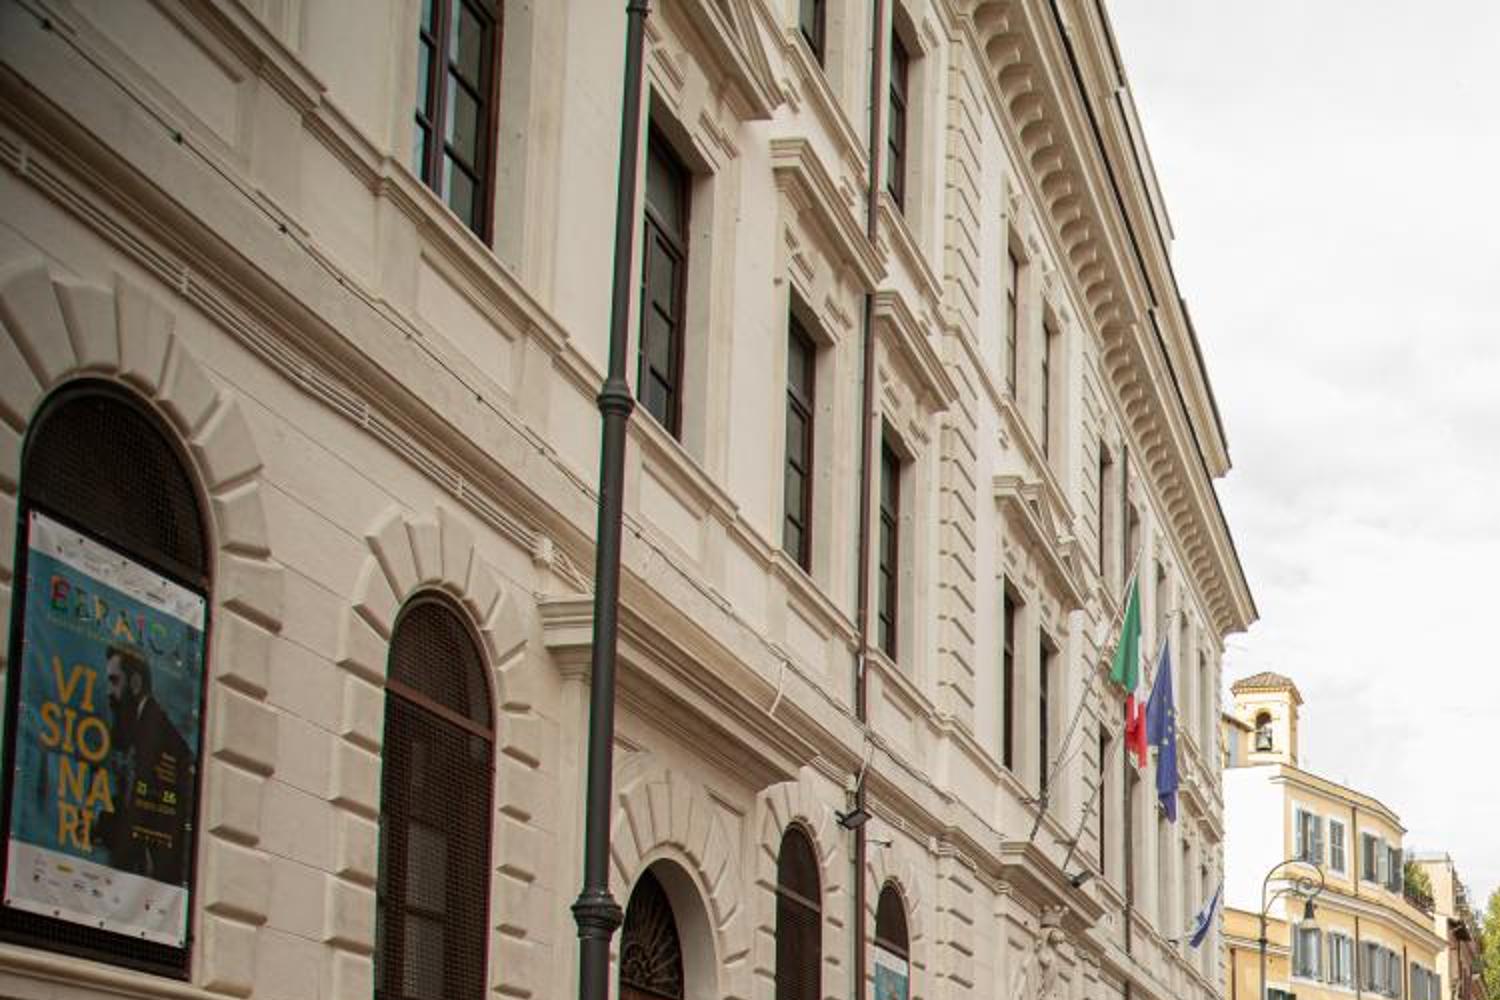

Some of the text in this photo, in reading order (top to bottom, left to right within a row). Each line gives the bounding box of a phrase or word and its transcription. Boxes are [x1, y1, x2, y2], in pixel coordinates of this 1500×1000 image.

[52, 656, 97, 713] VI
[38, 702, 111, 762] SIO
[57, 754, 115, 815] NA
[57, 801, 94, 853] RI
